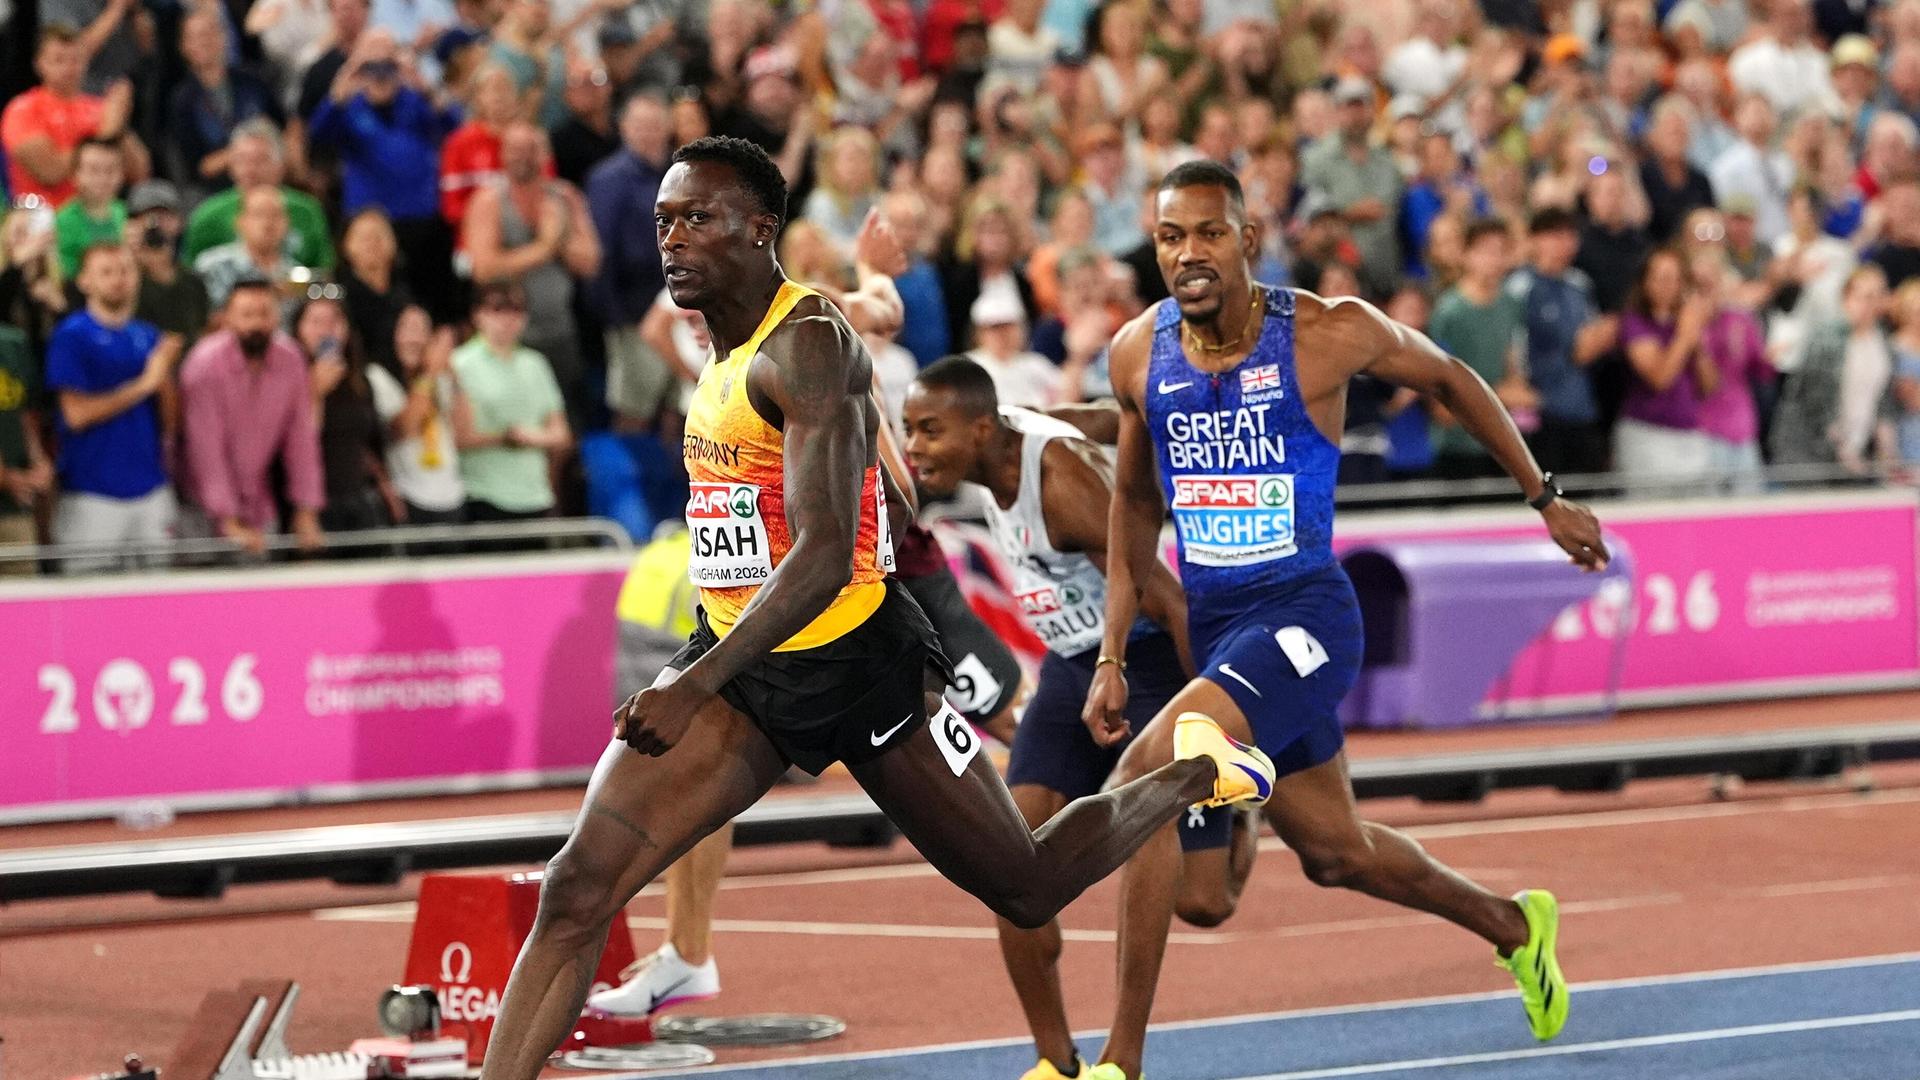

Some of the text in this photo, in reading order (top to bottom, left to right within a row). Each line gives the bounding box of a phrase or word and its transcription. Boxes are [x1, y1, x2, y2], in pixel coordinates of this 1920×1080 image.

[1166, 403, 1271, 442] GREAT
[1168, 434, 1286, 469] BRITAIN
[1176, 481, 1255, 504] SPAR
[1177, 513, 1290, 544] HUGHES
[734, 566, 768, 580] 2026
[954, 674, 976, 701] 9
[943, 712, 972, 755] 6
